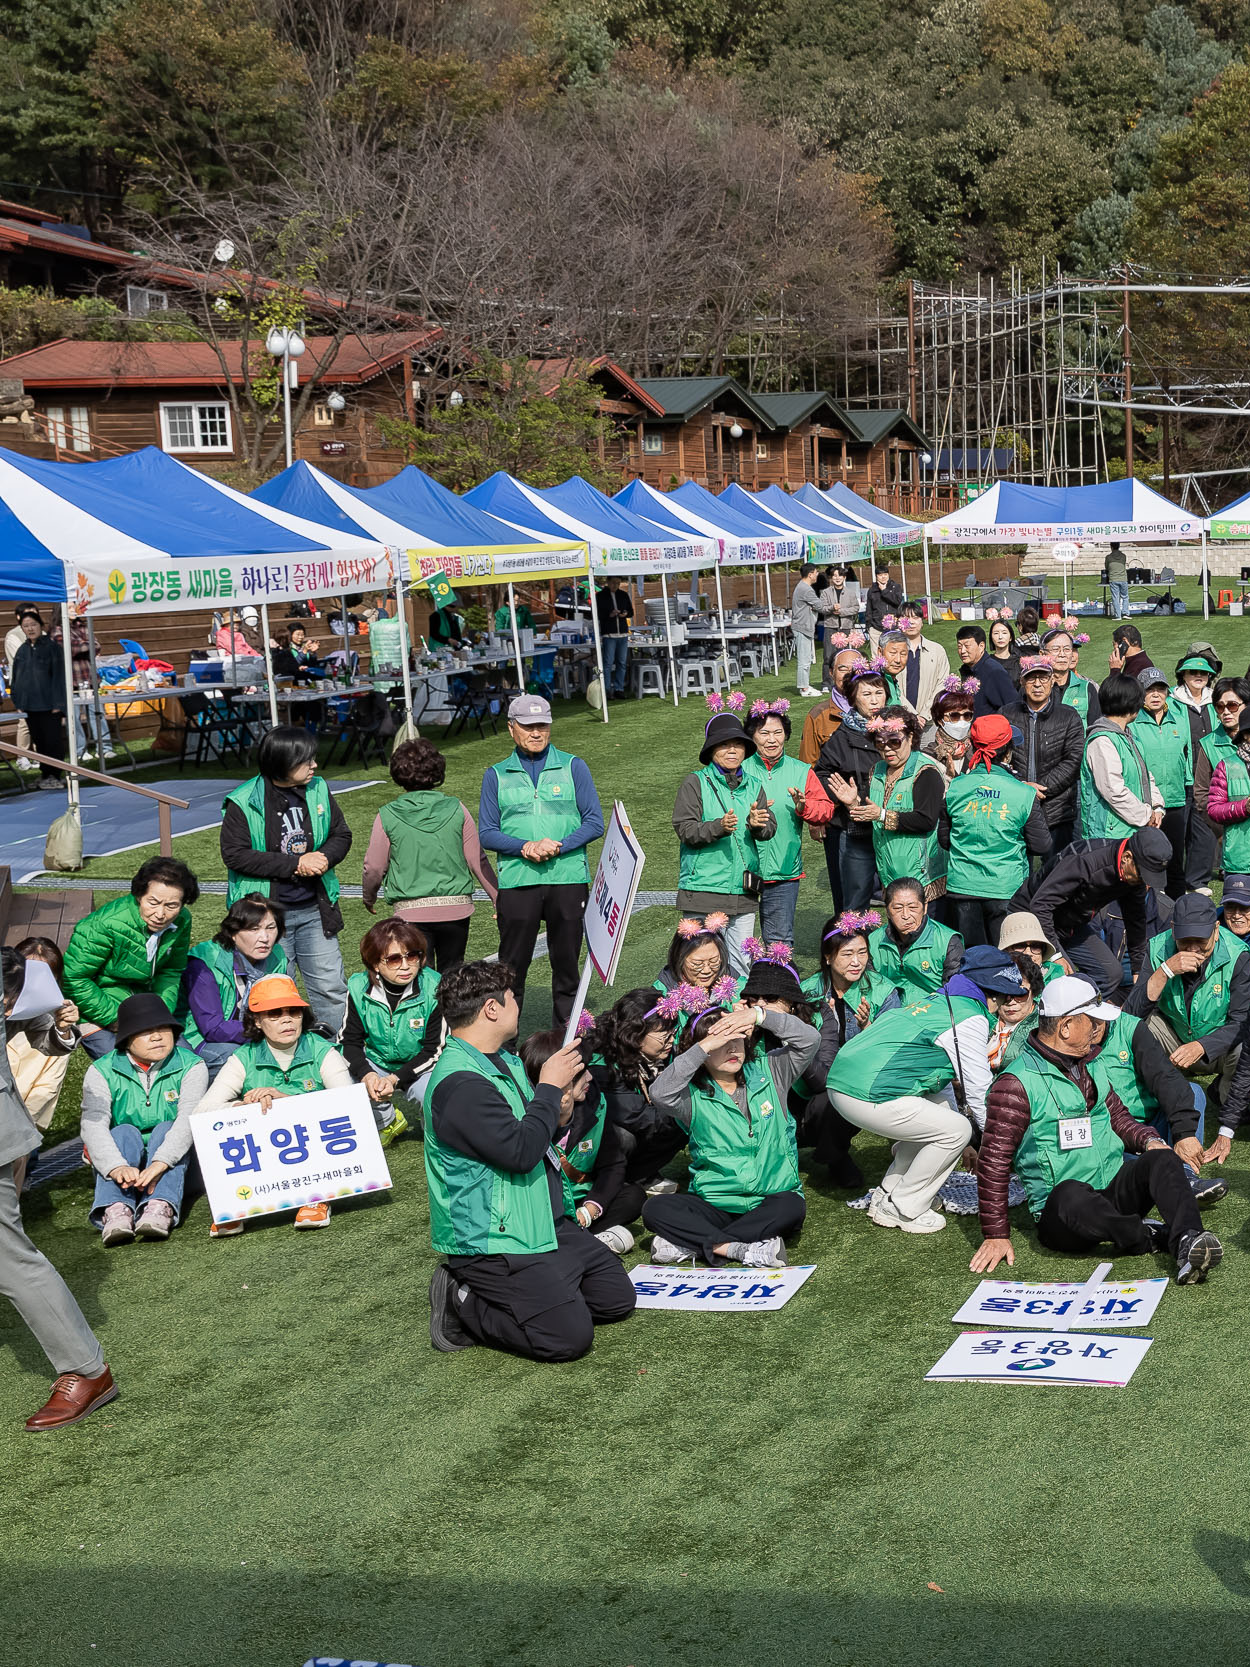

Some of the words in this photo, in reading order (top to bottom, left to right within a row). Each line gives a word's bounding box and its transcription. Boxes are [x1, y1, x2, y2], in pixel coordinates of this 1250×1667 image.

[954, 527, 997, 538] 광진구에서
[999, 527, 1016, 537] 가장
[1057, 526, 1084, 537] 구의1동
[1086, 524, 1137, 536] 새마을지도자
[131, 570, 182, 603] 광장동
[241, 564, 289, 596] 하나로!
[292, 561, 334, 592] 즐겁게!
[337, 557, 376, 588] 힘차게!
[975, 787, 1000, 799] SMU
[962, 800, 1011, 821] 새마을
[218, 1114, 358, 1177] 화양동
[254, 1164, 364, 1196] (사)서울광진구새마을회
[634, 1280, 786, 1299] 자양4동
[970, 1339, 1120, 1360] 자양3동
